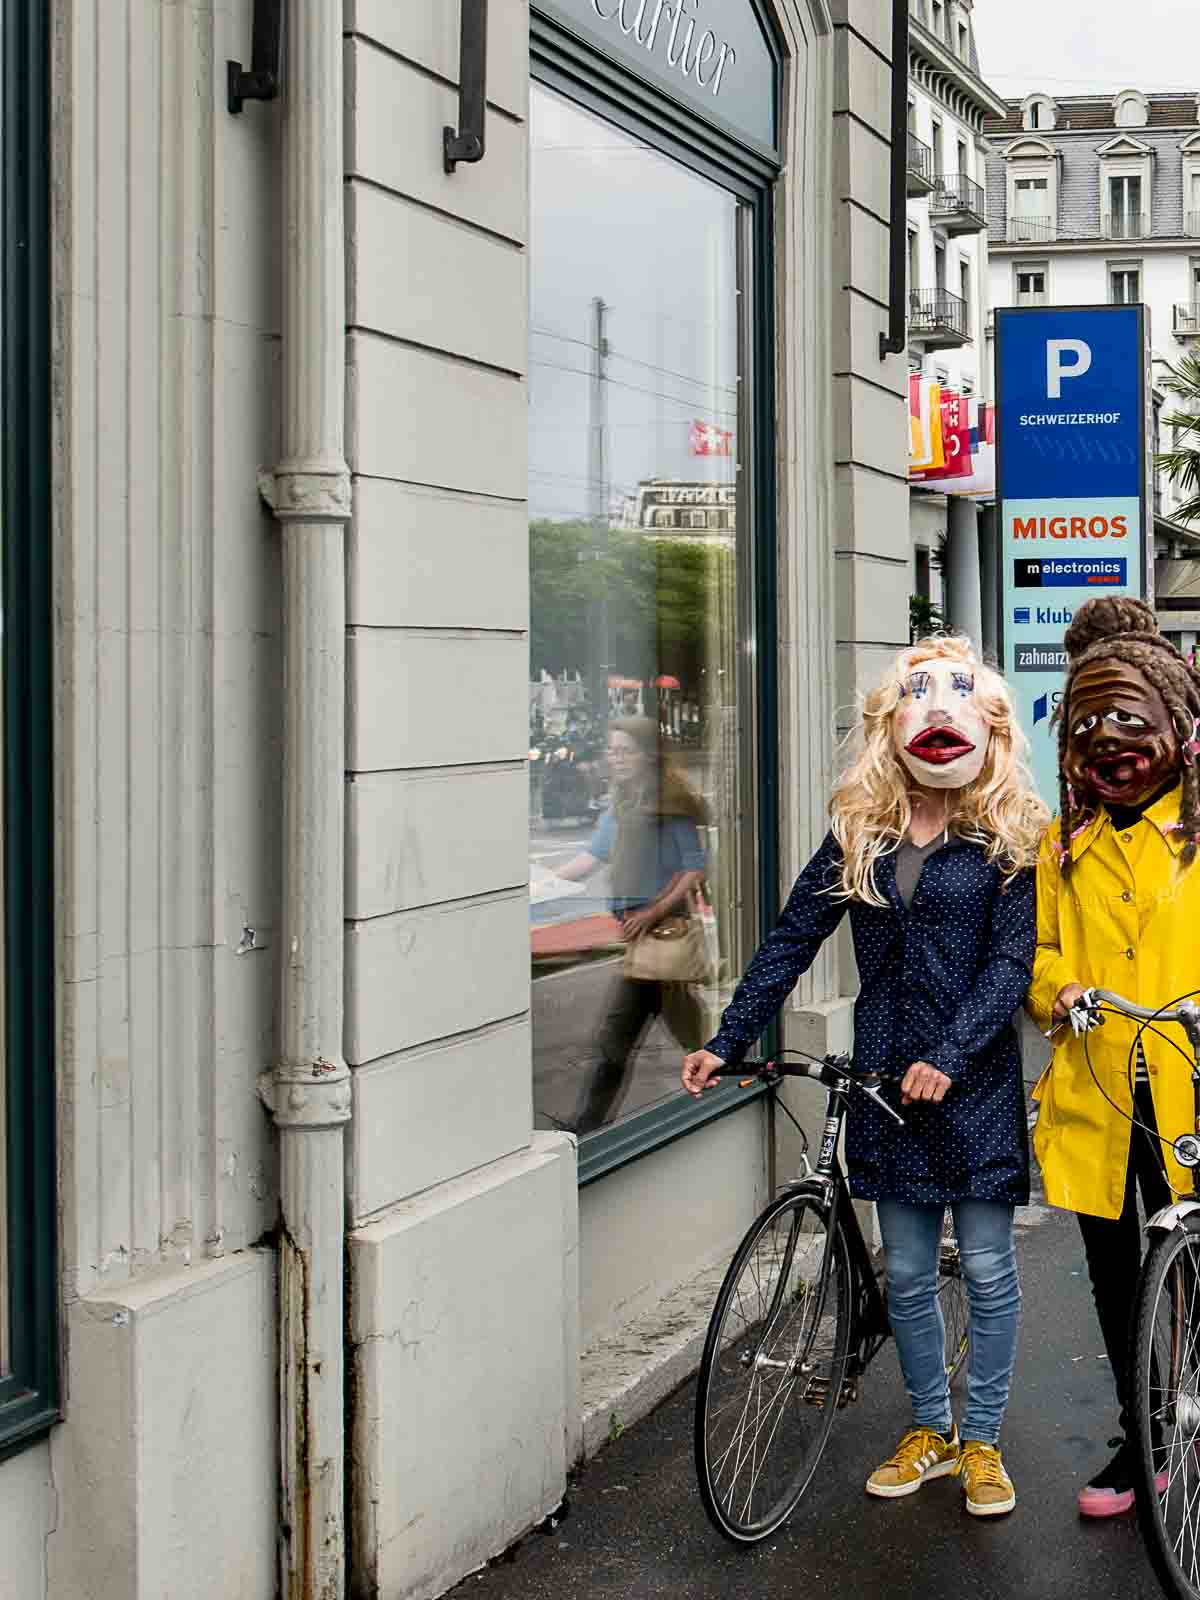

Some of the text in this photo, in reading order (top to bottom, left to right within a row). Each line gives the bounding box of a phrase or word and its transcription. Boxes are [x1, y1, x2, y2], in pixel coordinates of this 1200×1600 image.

[1046, 338, 1092, 399] P
[1019, 413, 1121, 426] SCHWEIZERHOF
[1012, 516, 1127, 539] MIGROS
